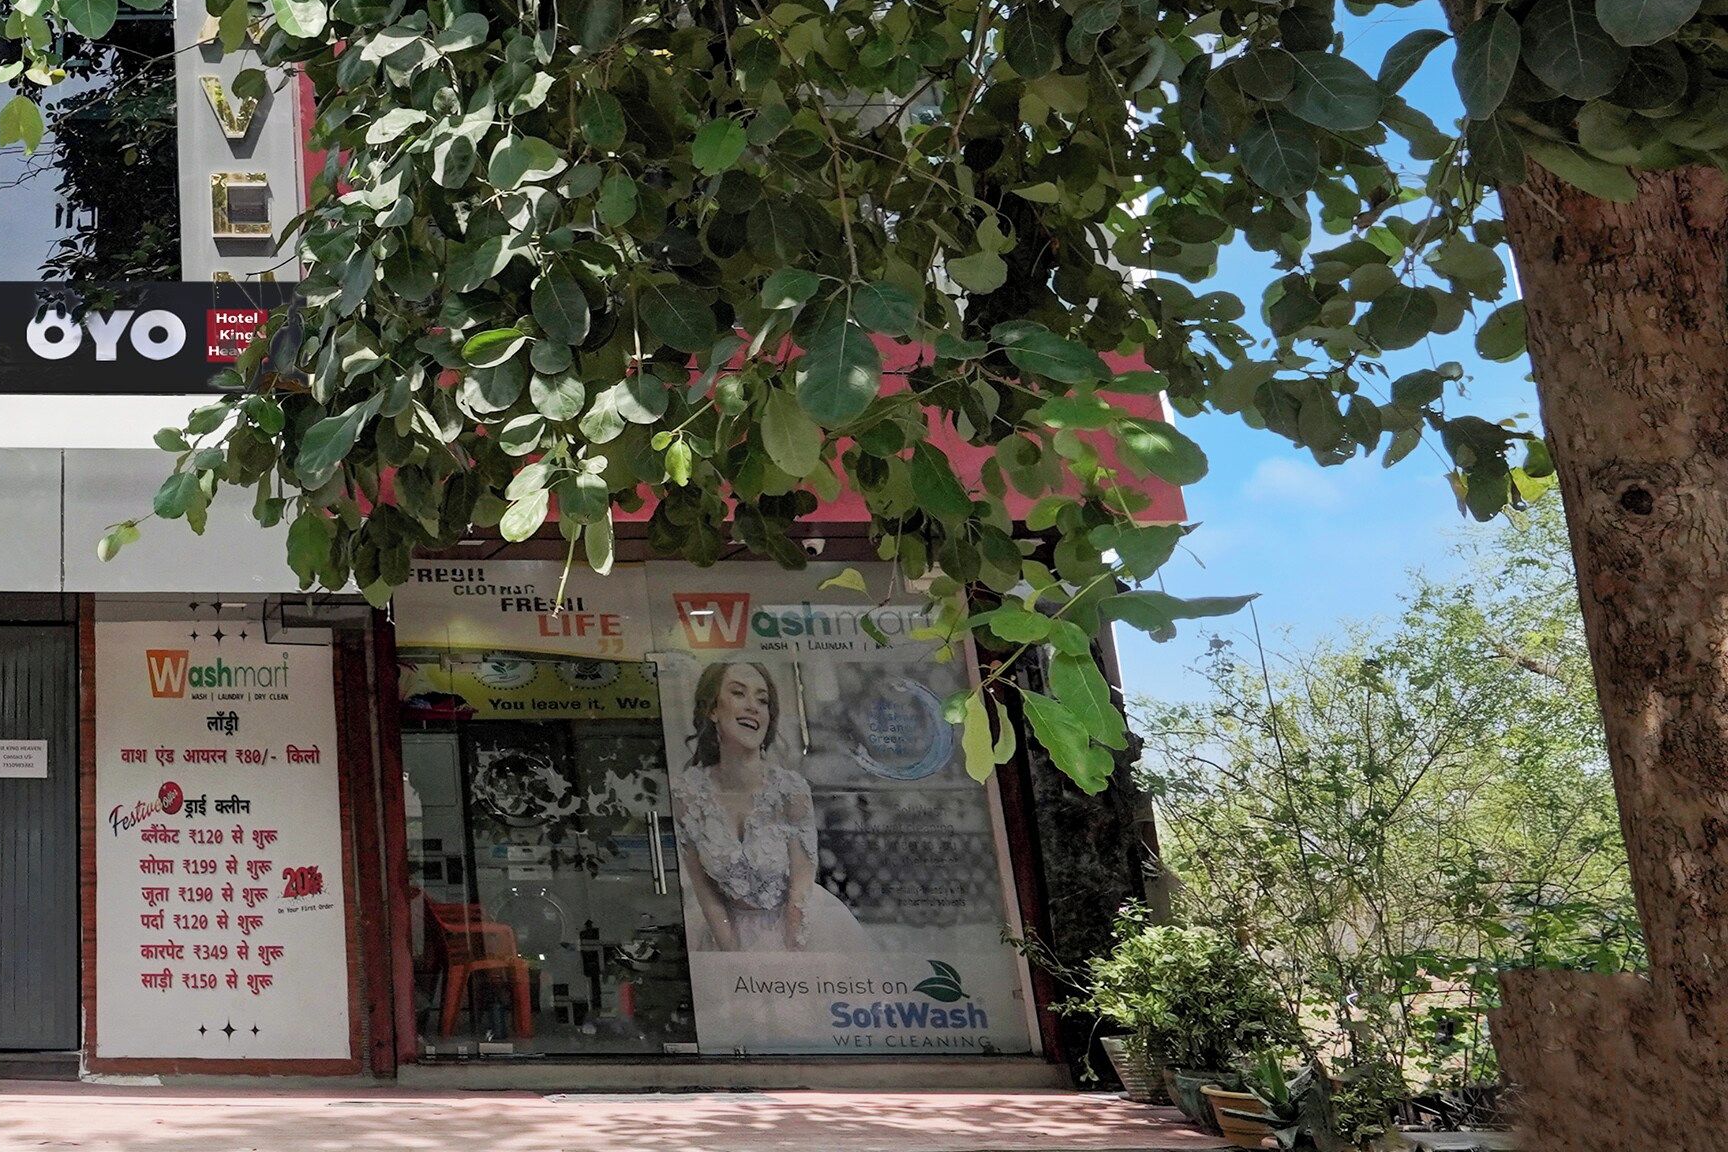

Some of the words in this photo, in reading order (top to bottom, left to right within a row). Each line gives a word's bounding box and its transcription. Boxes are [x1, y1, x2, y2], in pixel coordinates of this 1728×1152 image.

[216, 313, 258, 324] Hotel
[27, 309, 186, 361] OYO
[219, 329, 254, 343] King
[208, 346, 247, 356] Heav
[538, 613, 623, 637] LIFE
[149, 657, 290, 693] Washmart
[488, 698, 525, 710] You
[531, 698, 581, 710] leave
[588, 698, 606, 711] it,
[615, 697, 652, 710] We
[121, 749, 147, 764] वाश
[156, 746, 175, 766] एंड
[183, 749, 227, 764] आयरन
[236, 748, 277, 766] ₹80/-
[286, 744, 320, 764] किलो
[109, 799, 162, 838] Festive
[184, 794, 206, 818] ड्राई
[215, 795, 250, 814] क्लीन
[141, 824, 180, 844] ब्लैंकेट
[189, 829, 223, 844] ₹120
[231, 824, 244, 844] से
[252, 829, 278, 849] शुरू
[139, 854, 174, 876] सोफ़ा
[183, 859, 217, 874] ₹199
[225, 855, 238, 875] से
[246, 860, 272, 880] शुरू
[141, 887, 170, 907] जूता
[178, 887, 213, 902] ₹190
[221, 882, 234, 902] से
[242, 887, 268, 908] शुरू
[141, 909, 165, 930] पर्दा
[173, 914, 208, 930] ₹120
[216, 909, 229, 930] से
[237, 915, 263, 935] शुरू
[141, 939, 184, 960] कारपेट
[193, 944, 228, 960] ₹349
[237, 940, 249, 960] से
[258, 945, 285, 966] शुरू
[141, 968, 173, 993] साड़ी
[182, 973, 217, 989] ₹150
[225, 969, 238, 989] से
[247, 974, 273, 995] शुरू
[734, 976, 810, 998] Always
[816, 976, 874, 994] insist
[882, 979, 908, 994] on
[830, 1001, 988, 1029] SoftWash
[832, 1034, 872, 1047] WET
[885, 1034, 992, 1048] CLEANING
